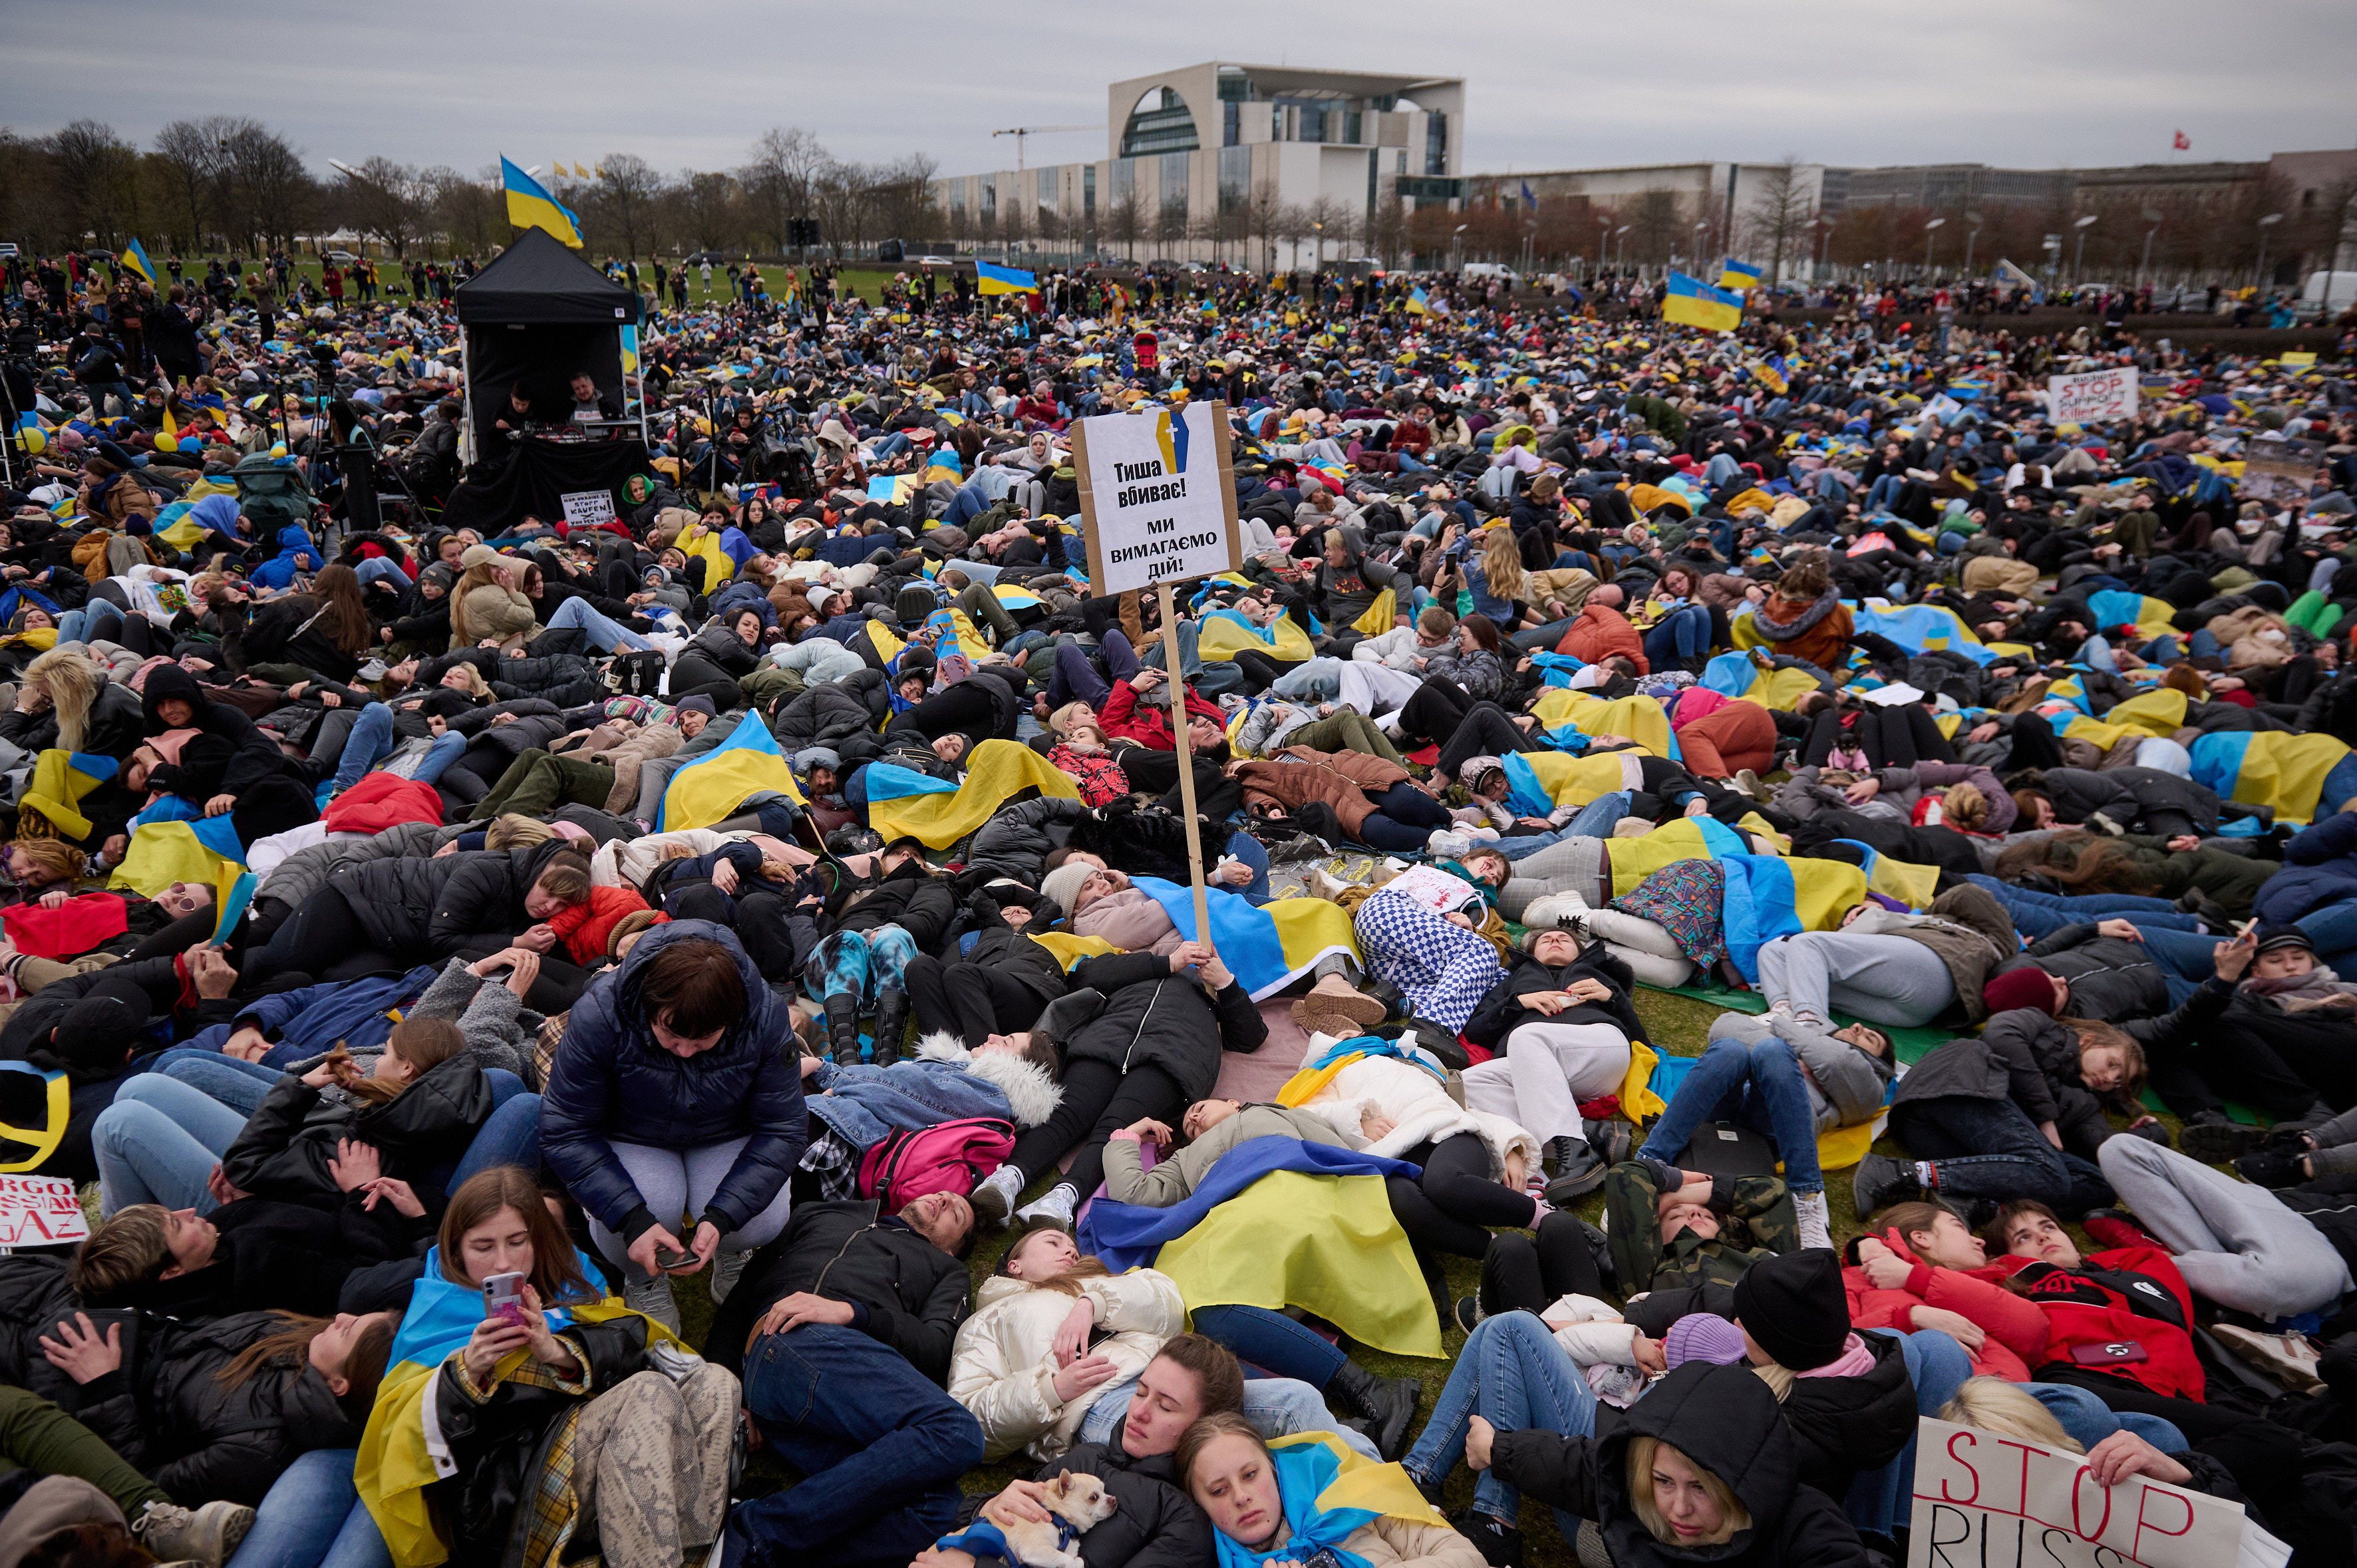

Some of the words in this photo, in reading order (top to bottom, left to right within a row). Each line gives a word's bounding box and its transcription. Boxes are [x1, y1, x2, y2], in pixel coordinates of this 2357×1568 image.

[2063, 378, 2123, 398] STOP
[2106, 401, 2123, 414] Z
[1114, 460, 1162, 483] Тиша
[1118, 478, 1187, 508] вбиває!
[1110, 532, 1217, 563] ВИМАГАЄМО
[1148, 556, 1183, 580] ДІЙ!
[1941, 1431, 2194, 1560] STOP
